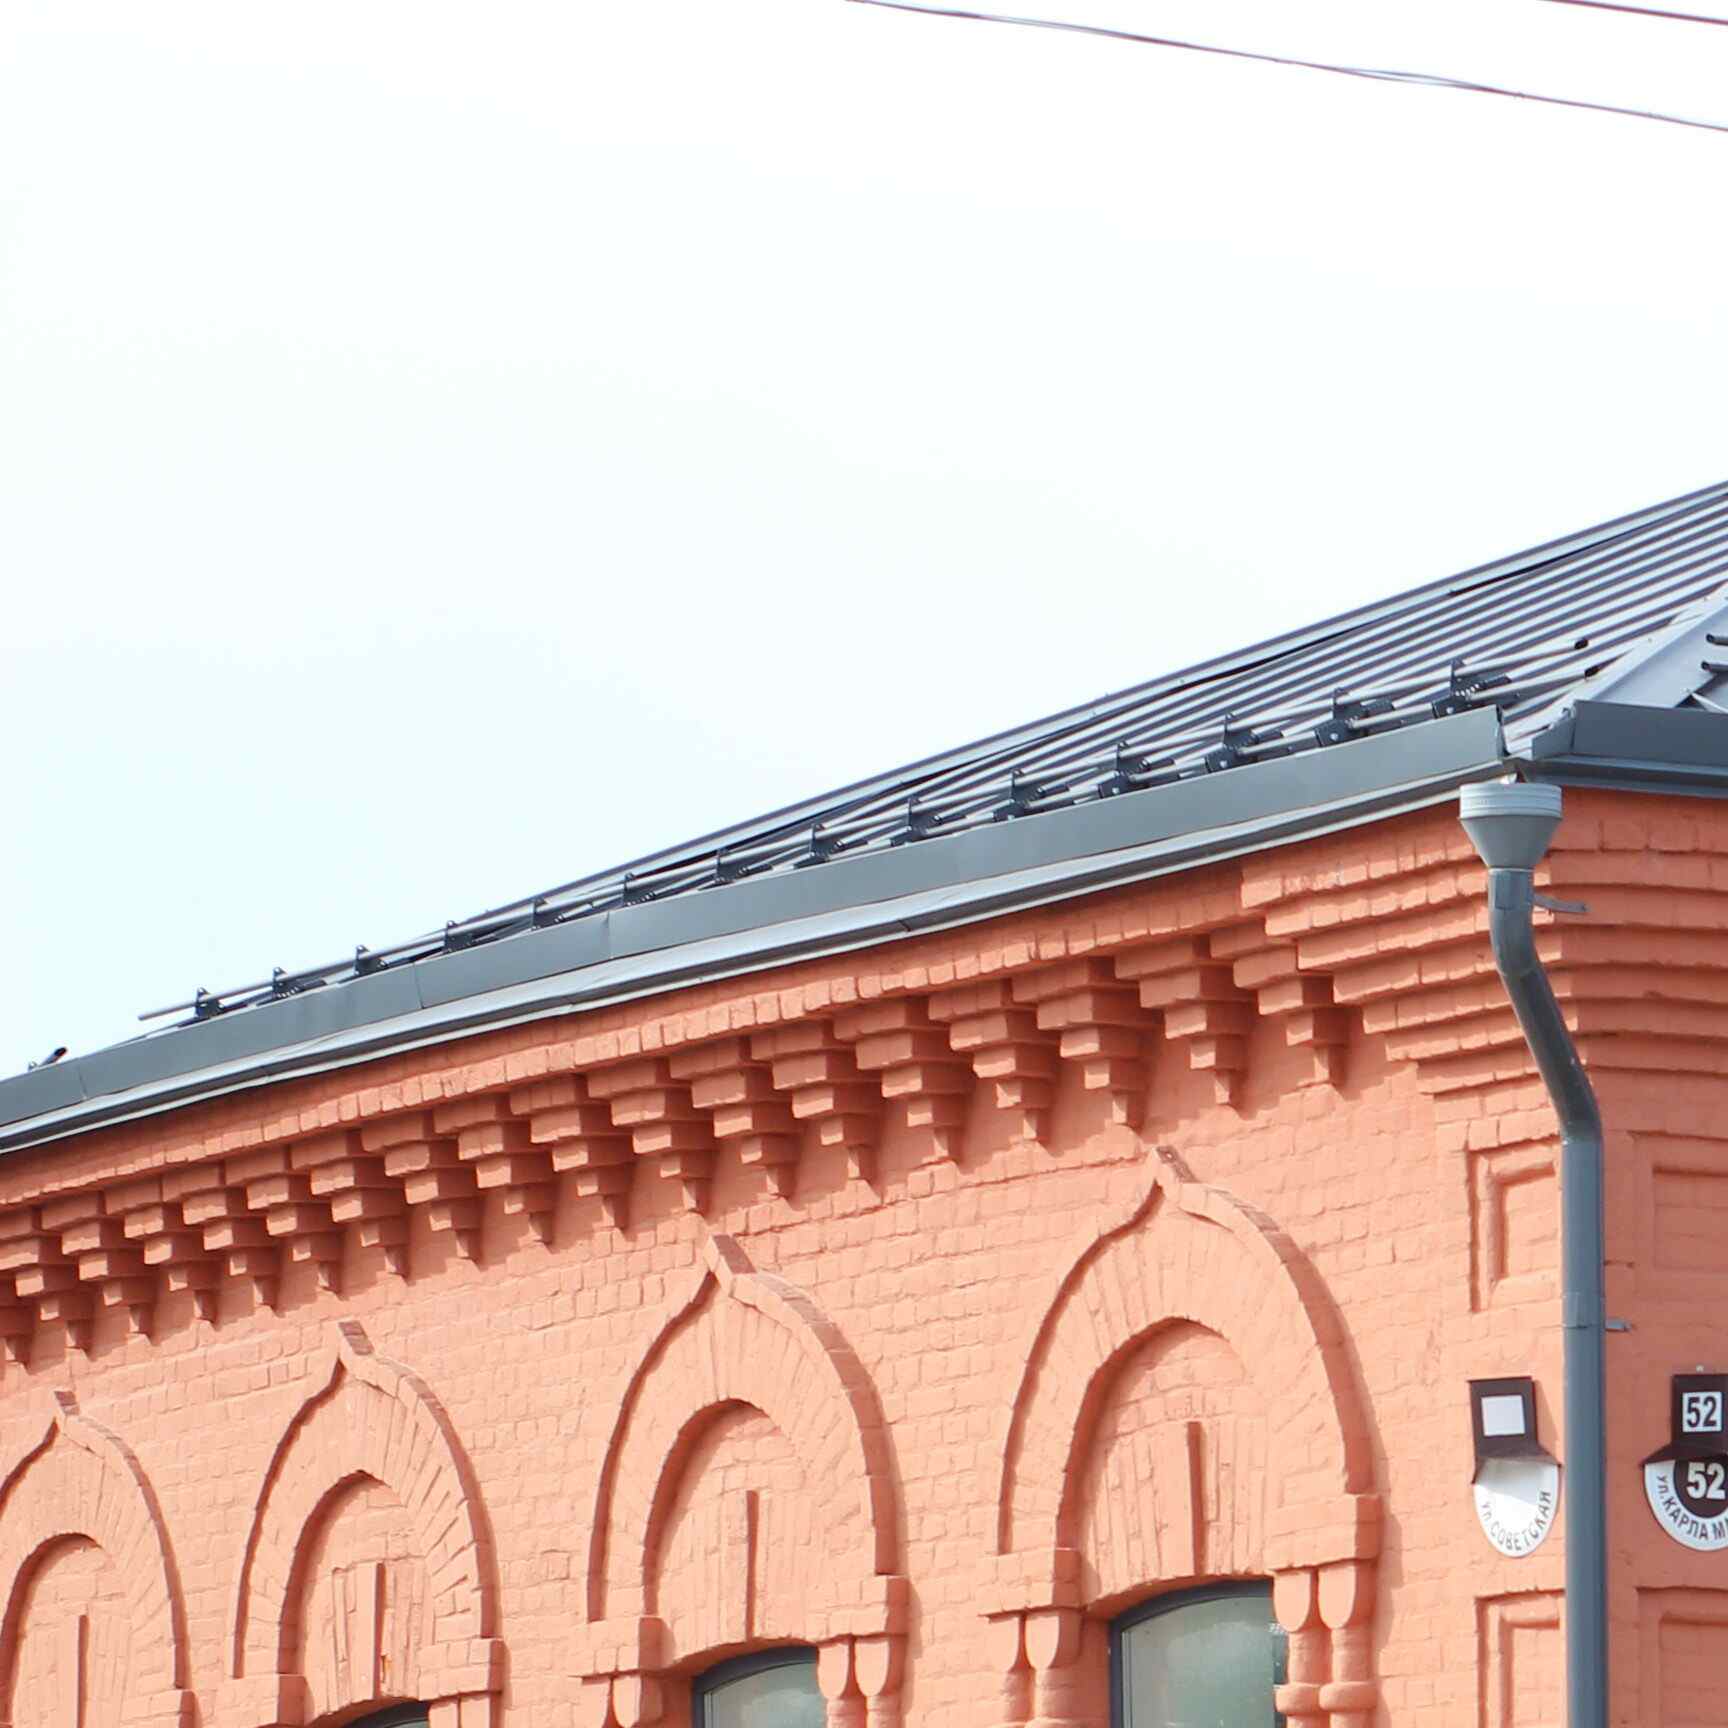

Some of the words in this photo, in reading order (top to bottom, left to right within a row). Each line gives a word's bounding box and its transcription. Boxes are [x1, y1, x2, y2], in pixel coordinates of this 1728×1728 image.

[1687, 1396, 1718, 1428] 52
[1686, 1461, 1727, 1500] 52
[1490, 1490, 1552, 1551] СОВЕТСКАЯ
[1663, 1496, 1709, 1541] КАРЛА
